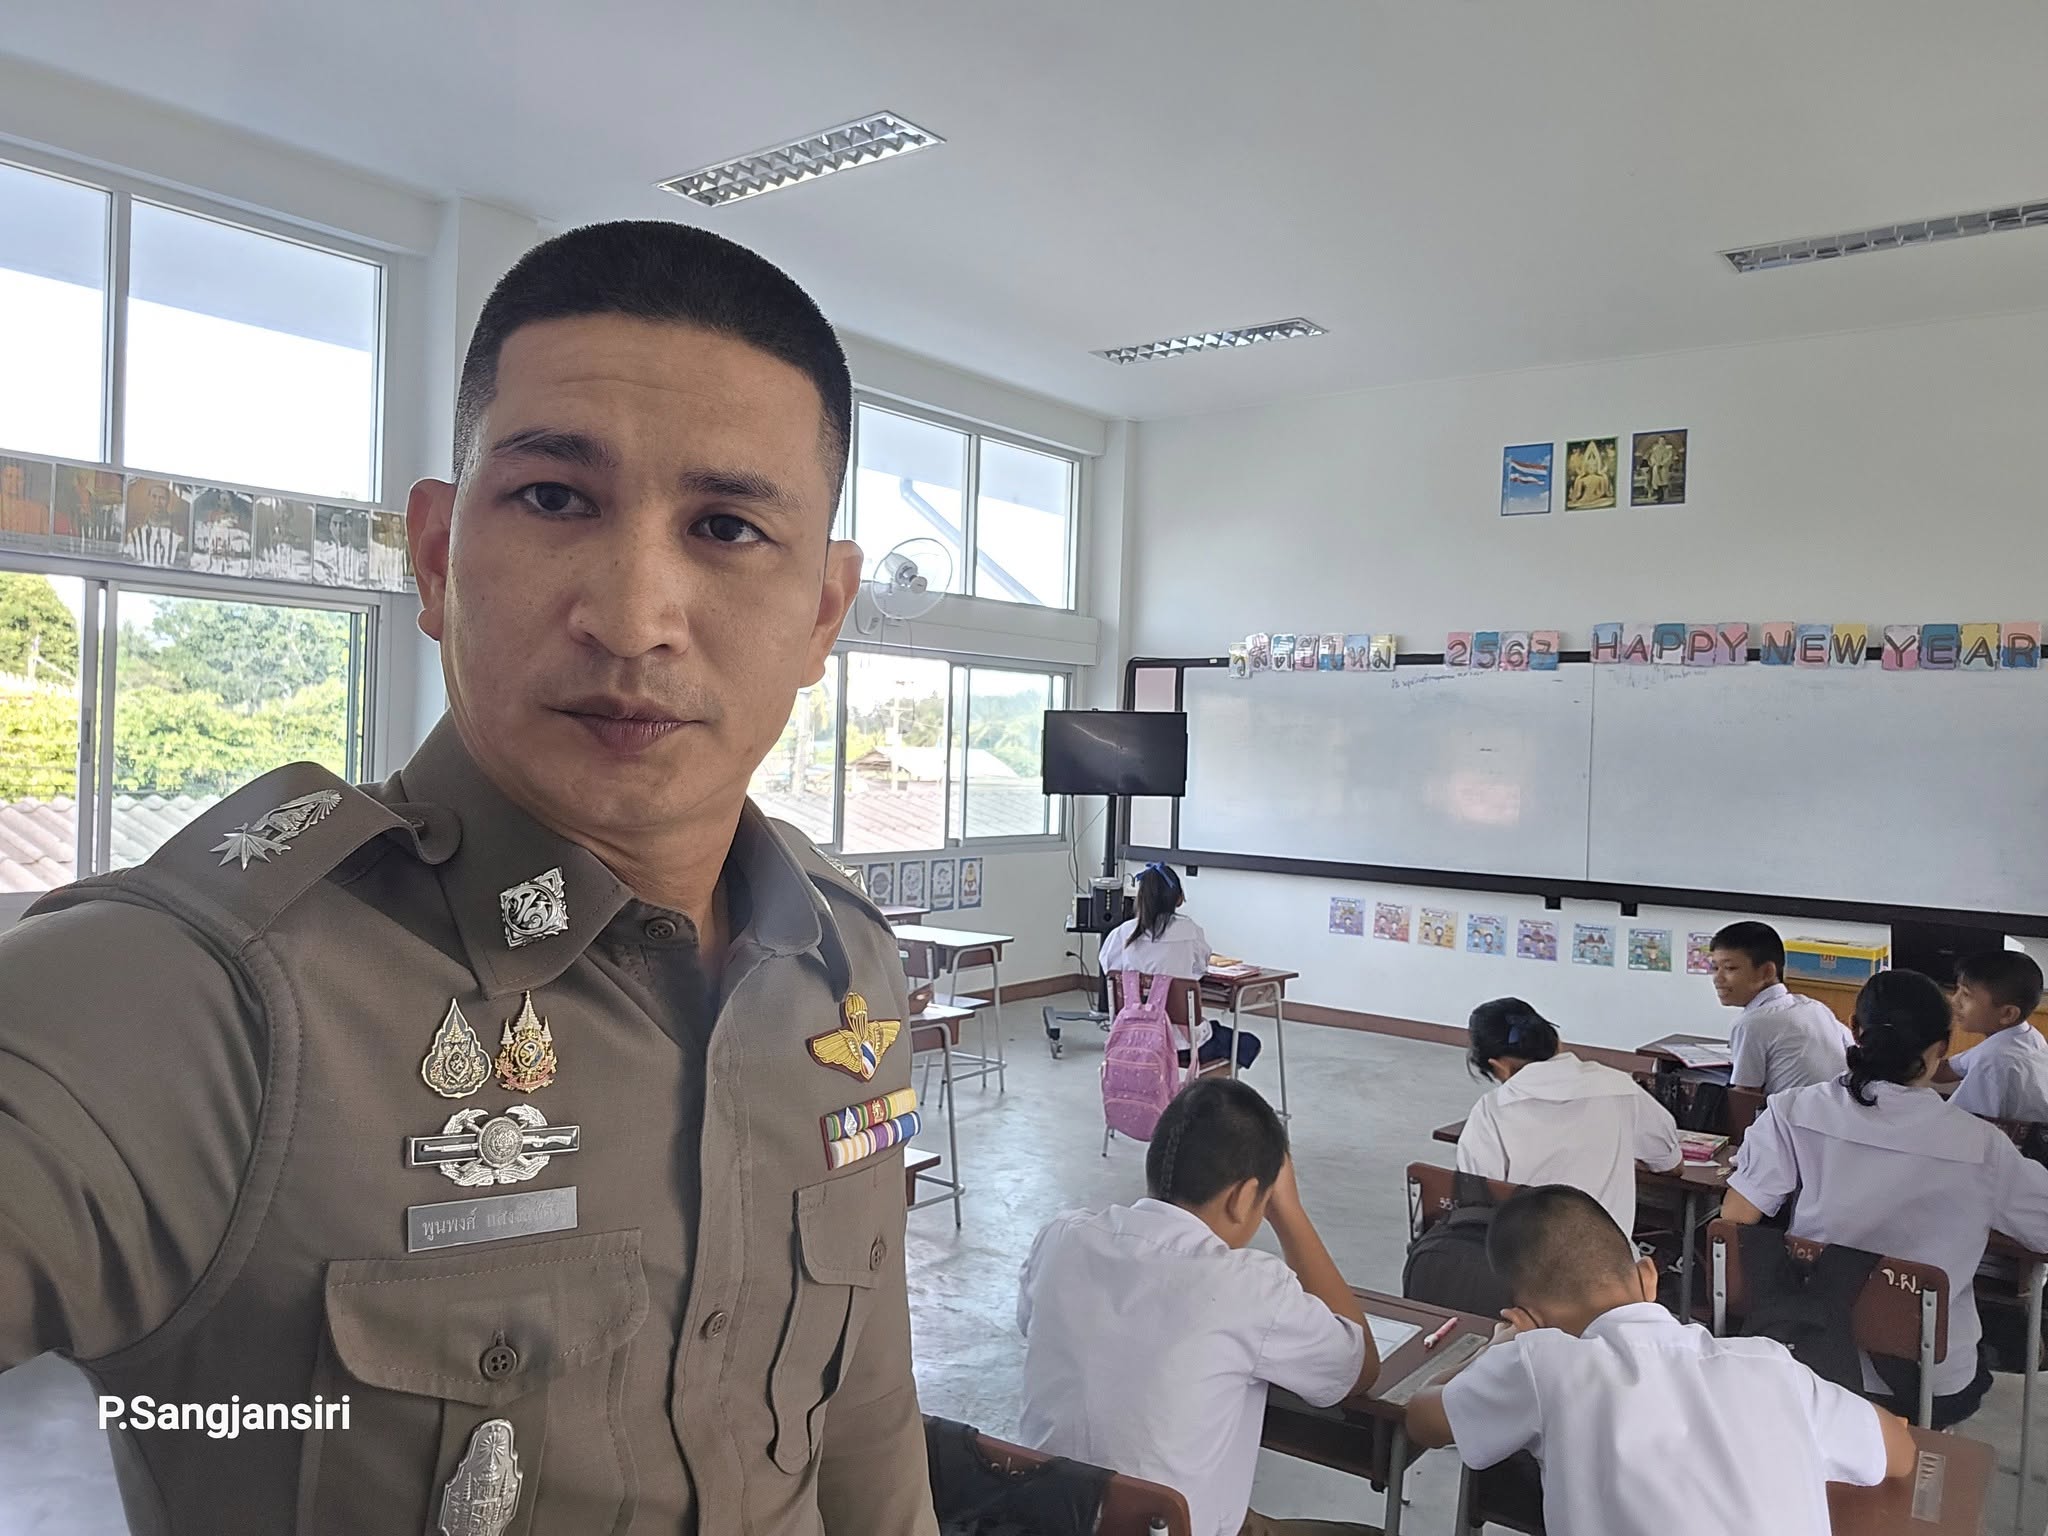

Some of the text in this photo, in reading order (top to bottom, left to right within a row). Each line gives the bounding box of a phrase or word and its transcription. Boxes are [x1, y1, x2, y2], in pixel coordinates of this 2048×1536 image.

[1447, 637, 1553, 668] 2567
[1593, 631, 2037, 668] HAPPY NEW YEAR
